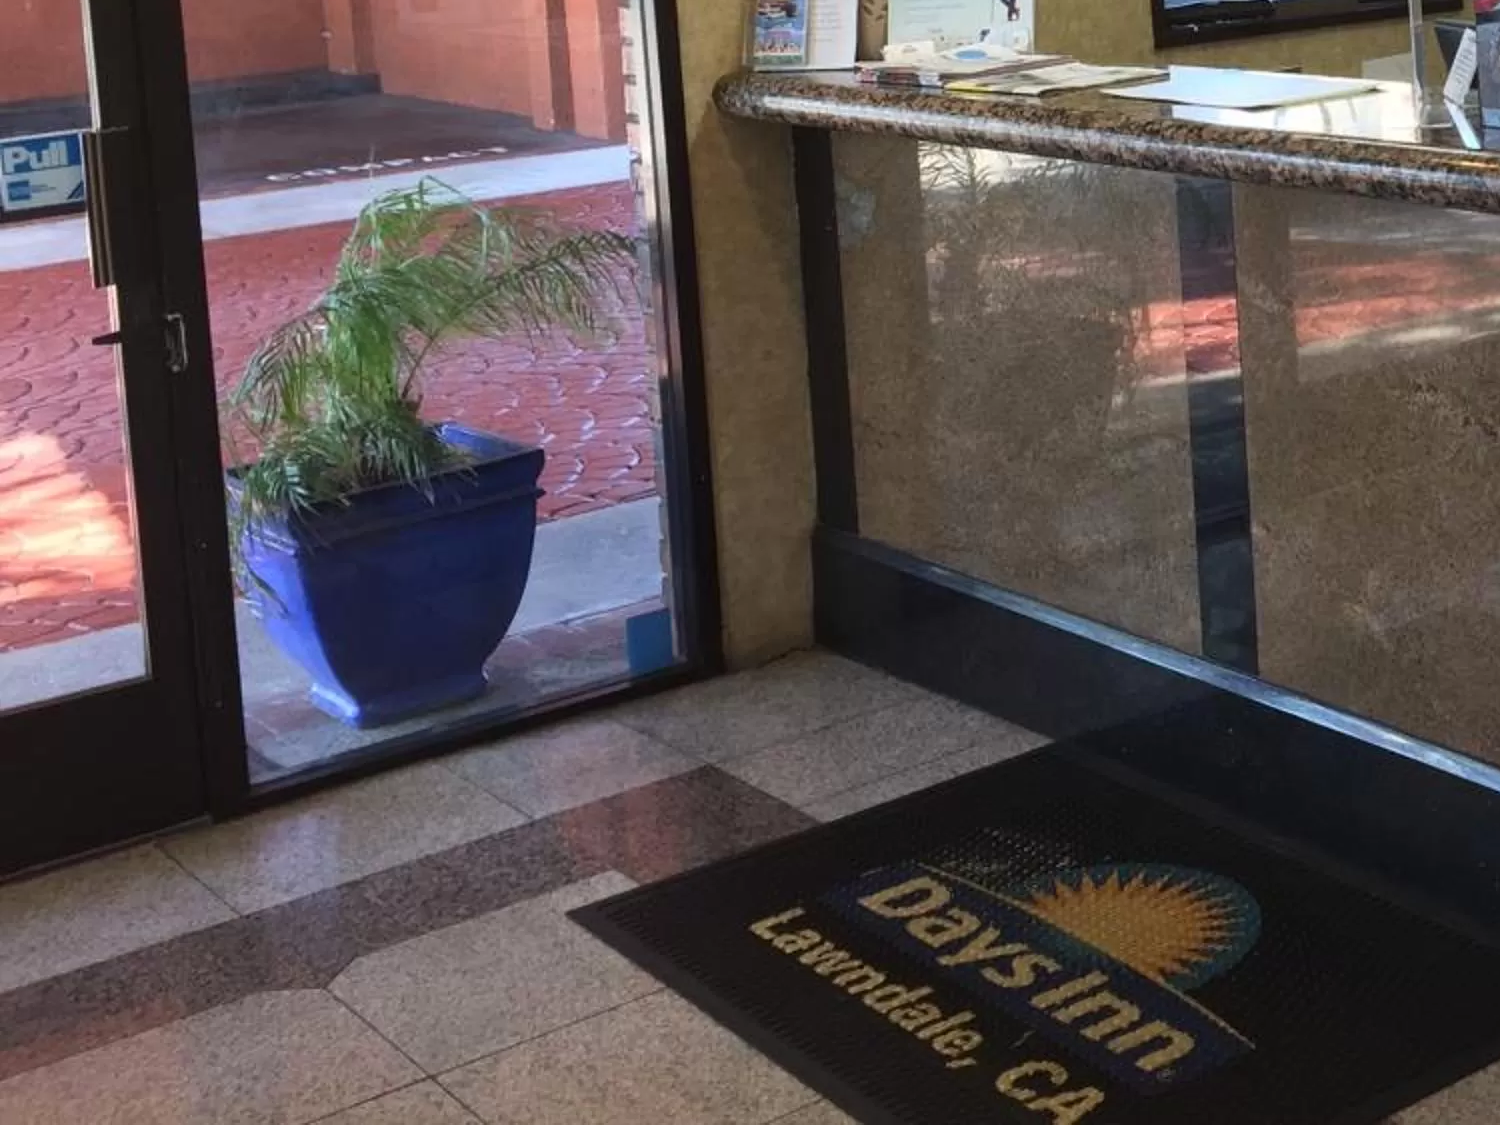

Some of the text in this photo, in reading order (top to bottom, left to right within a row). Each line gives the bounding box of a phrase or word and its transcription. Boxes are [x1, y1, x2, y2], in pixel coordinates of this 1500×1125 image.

[4, 140, 68, 173] Pull
[748, 907, 1105, 1125] Lawndale, CA
[855, 875, 1197, 1074] Days Inn
